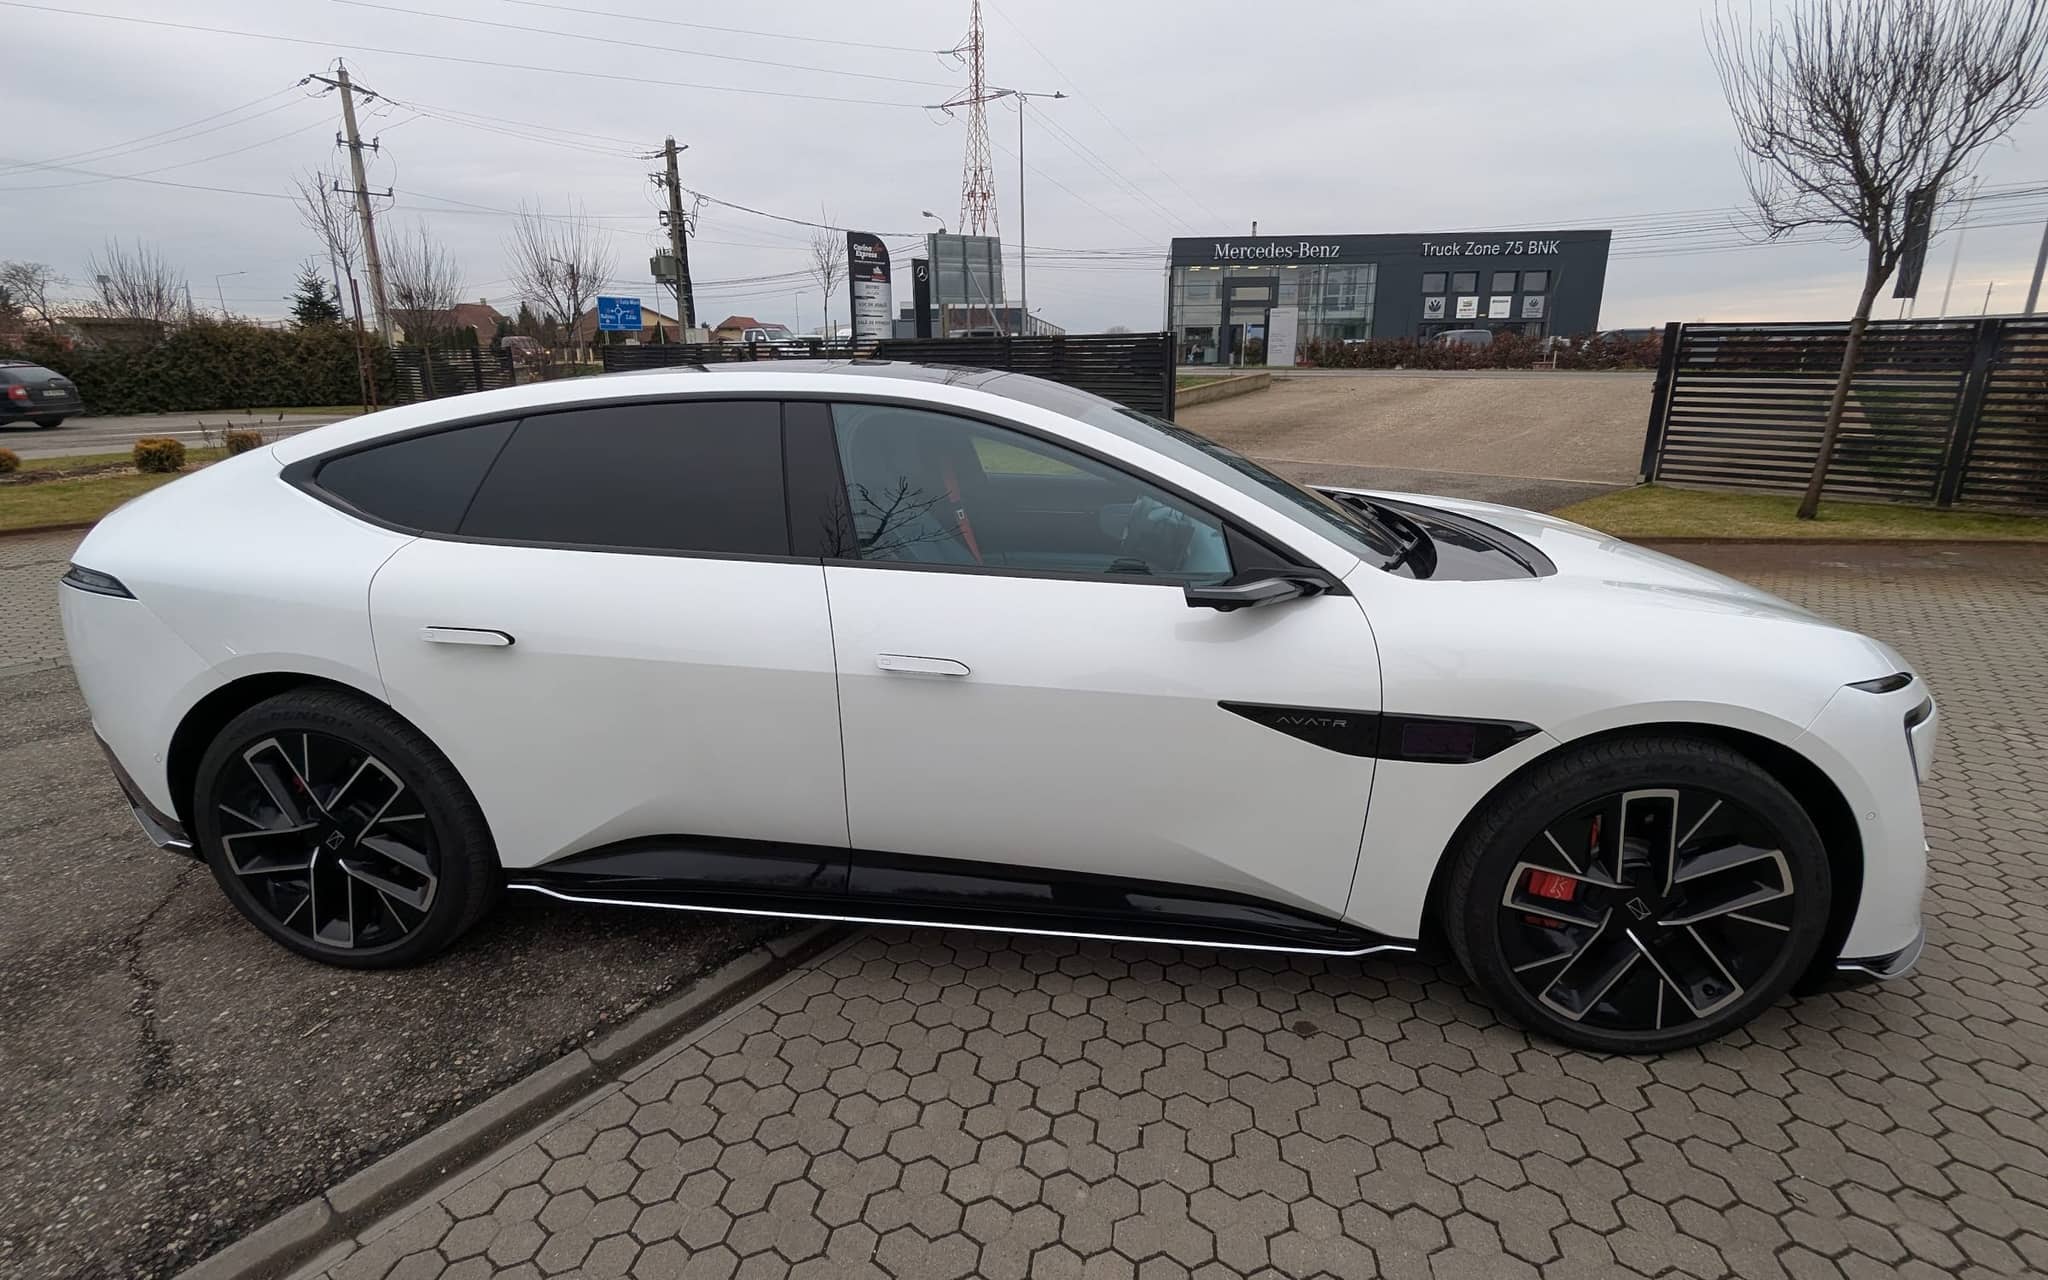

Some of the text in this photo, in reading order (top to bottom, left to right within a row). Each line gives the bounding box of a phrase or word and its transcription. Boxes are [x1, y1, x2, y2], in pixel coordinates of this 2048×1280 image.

[1214, 242, 1340, 260] Mercedes-Benz
[1422, 240, 1560, 256] Truck Zone 75 BNK
[1275, 715, 1348, 728] AVATR
